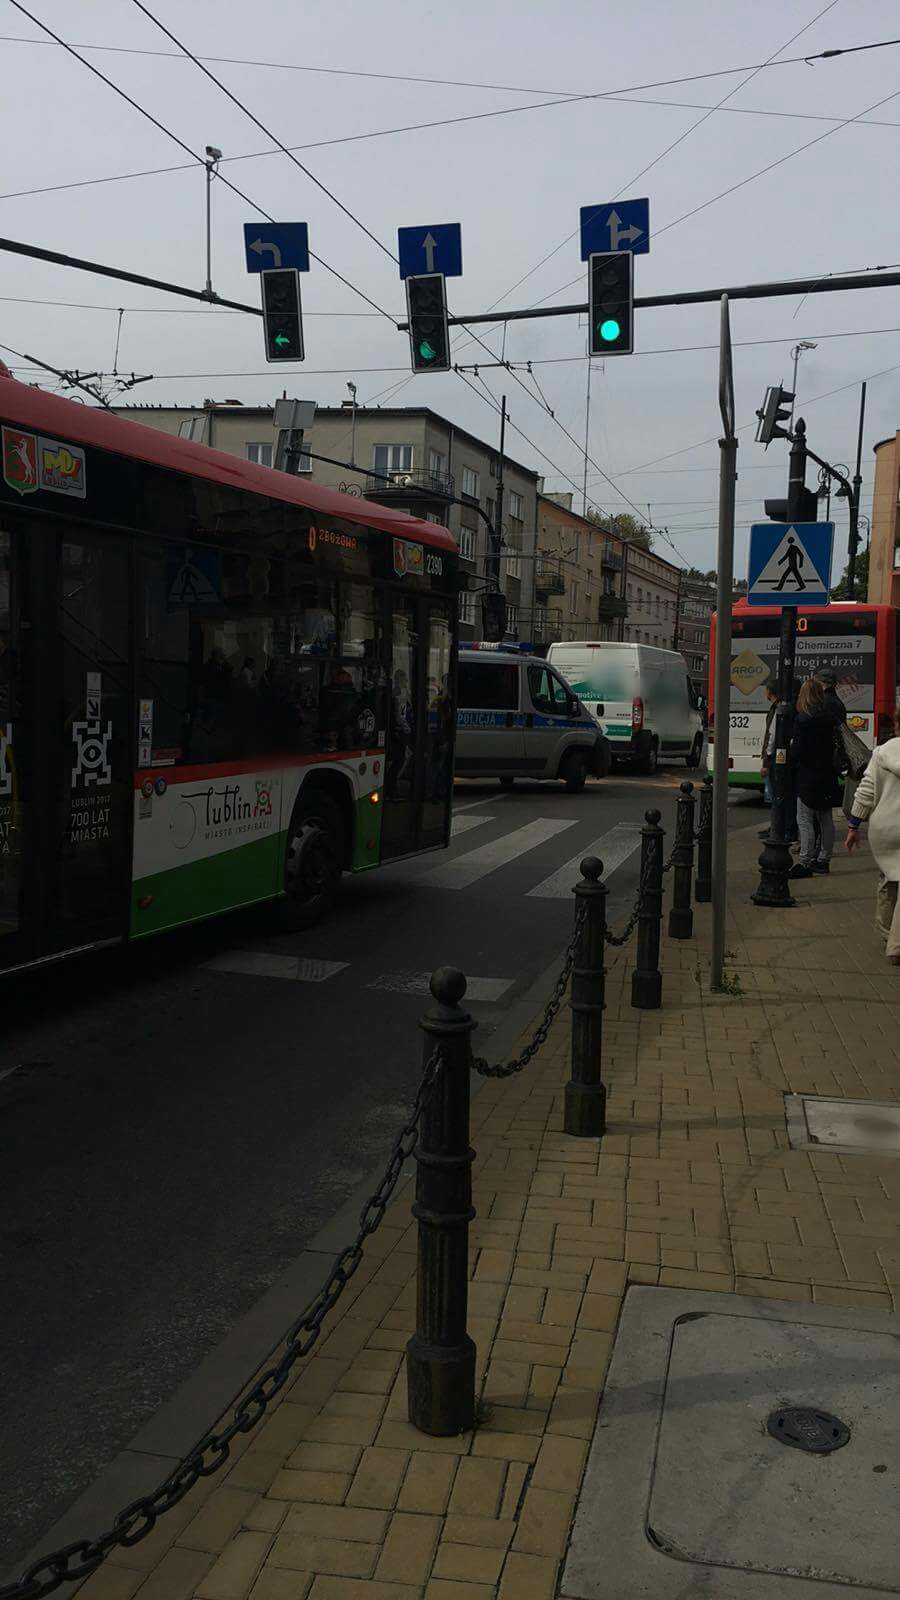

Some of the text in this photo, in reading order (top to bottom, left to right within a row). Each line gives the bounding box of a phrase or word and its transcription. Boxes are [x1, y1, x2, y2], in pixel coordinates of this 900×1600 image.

[797, 640, 852, 650] Chemiczna
[855, 640, 862, 649] 7
[830, 656, 863, 667] drzwi
[456, 713, 496, 727] POLICJA
[71, 808, 111, 828] 700 LAT
[70, 825, 110, 844] MIASTA
